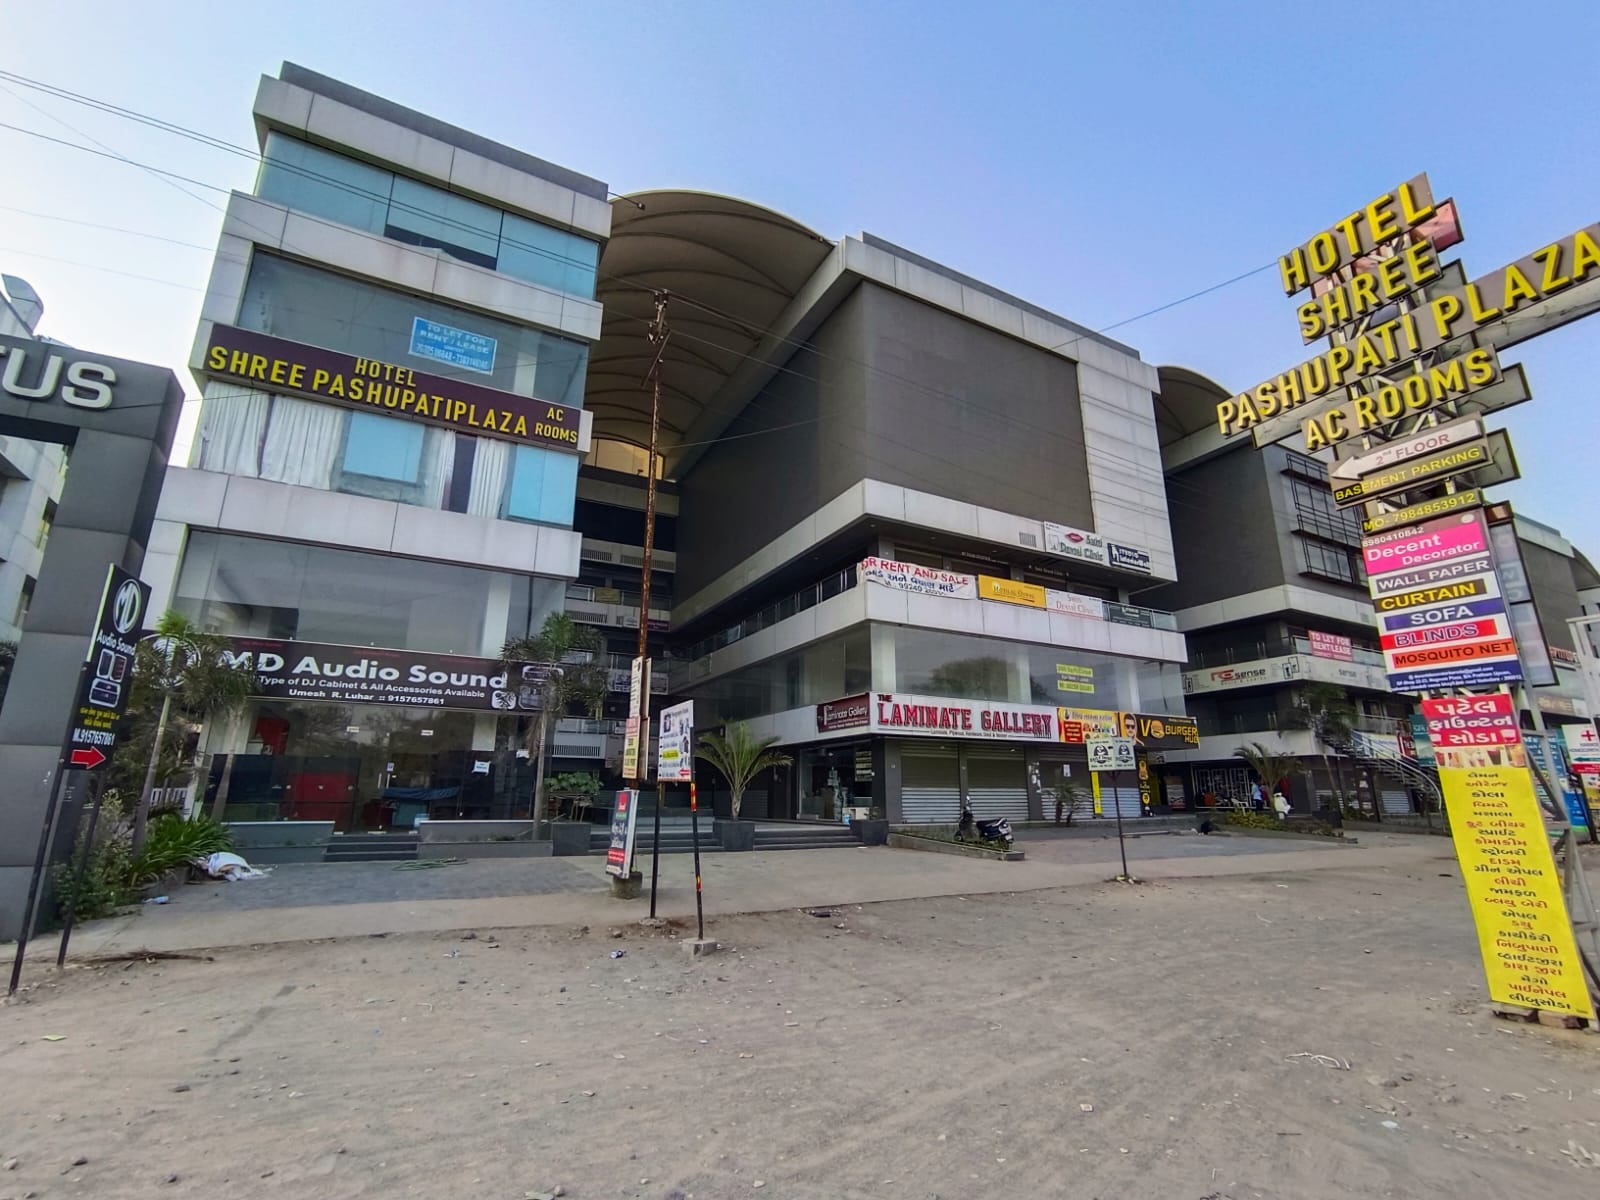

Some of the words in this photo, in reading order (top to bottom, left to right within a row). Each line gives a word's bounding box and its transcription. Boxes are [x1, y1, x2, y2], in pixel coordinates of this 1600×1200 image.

[1278, 182, 1437, 295] HOTEL
[1297, 238, 1441, 341] SHREE
[1215, 313, 1423, 438] PASHUPATI
[1431, 229, 1600, 341] PLAZA
[0, 346, 116, 408] US
[208, 345, 306, 388] SHREE
[354, 357, 416, 387] HOTEL
[1305, 409, 1349, 450] AC
[1354, 350, 1497, 430] ROOMS
[547, 407, 564, 422] AC
[535, 422, 578, 443] ROOMS
[1395, 433, 1451, 458] FLOOR
[1335, 470, 1407, 501] BASEMENT
[1411, 447, 1481, 476] PARKING
[1367, 533, 1443, 562] Decent
[1402, 540, 1480, 565] Decorator
[880, 560, 911, 574] RENT
[914, 567, 938, 580] AND
[940, 574, 969, 586] SALE
[1379, 573, 1426, 590] WALL
[1428, 559, 1490, 580] PAPER
[1381, 582, 1476, 610] CURTAIN
[1410, 605, 1475, 625] SOFA
[1394, 623, 1479, 648] BLINDS
[1395, 646, 1475, 665] MOSQUITO
[1479, 641, 1512, 655] NET
[292, 656, 400, 681] Audio
[408, 664, 508, 688] Sound
[259, 676, 285, 685] Type
[287, 678, 299, 686] of
[301, 679, 316, 687] DJ
[319, 680, 358, 690] Cabinet
[360, 682, 368, 690] &
[369, 683, 384, 691] All
[386, 684, 442, 696] Accessories
[443, 689, 486, 698] Available
[289, 689, 326, 697] Umesh
[344, 692, 375, 700] Luhar
[877, 694, 893, 703] THE
[877, 702, 973, 731] LAMINATE
[981, 709, 1052, 735] GALLERY
[1434, 698, 1498, 716] પટેલ
[1164, 724, 1198, 736] BURGER
[1449, 730, 1498, 744] સોડા
